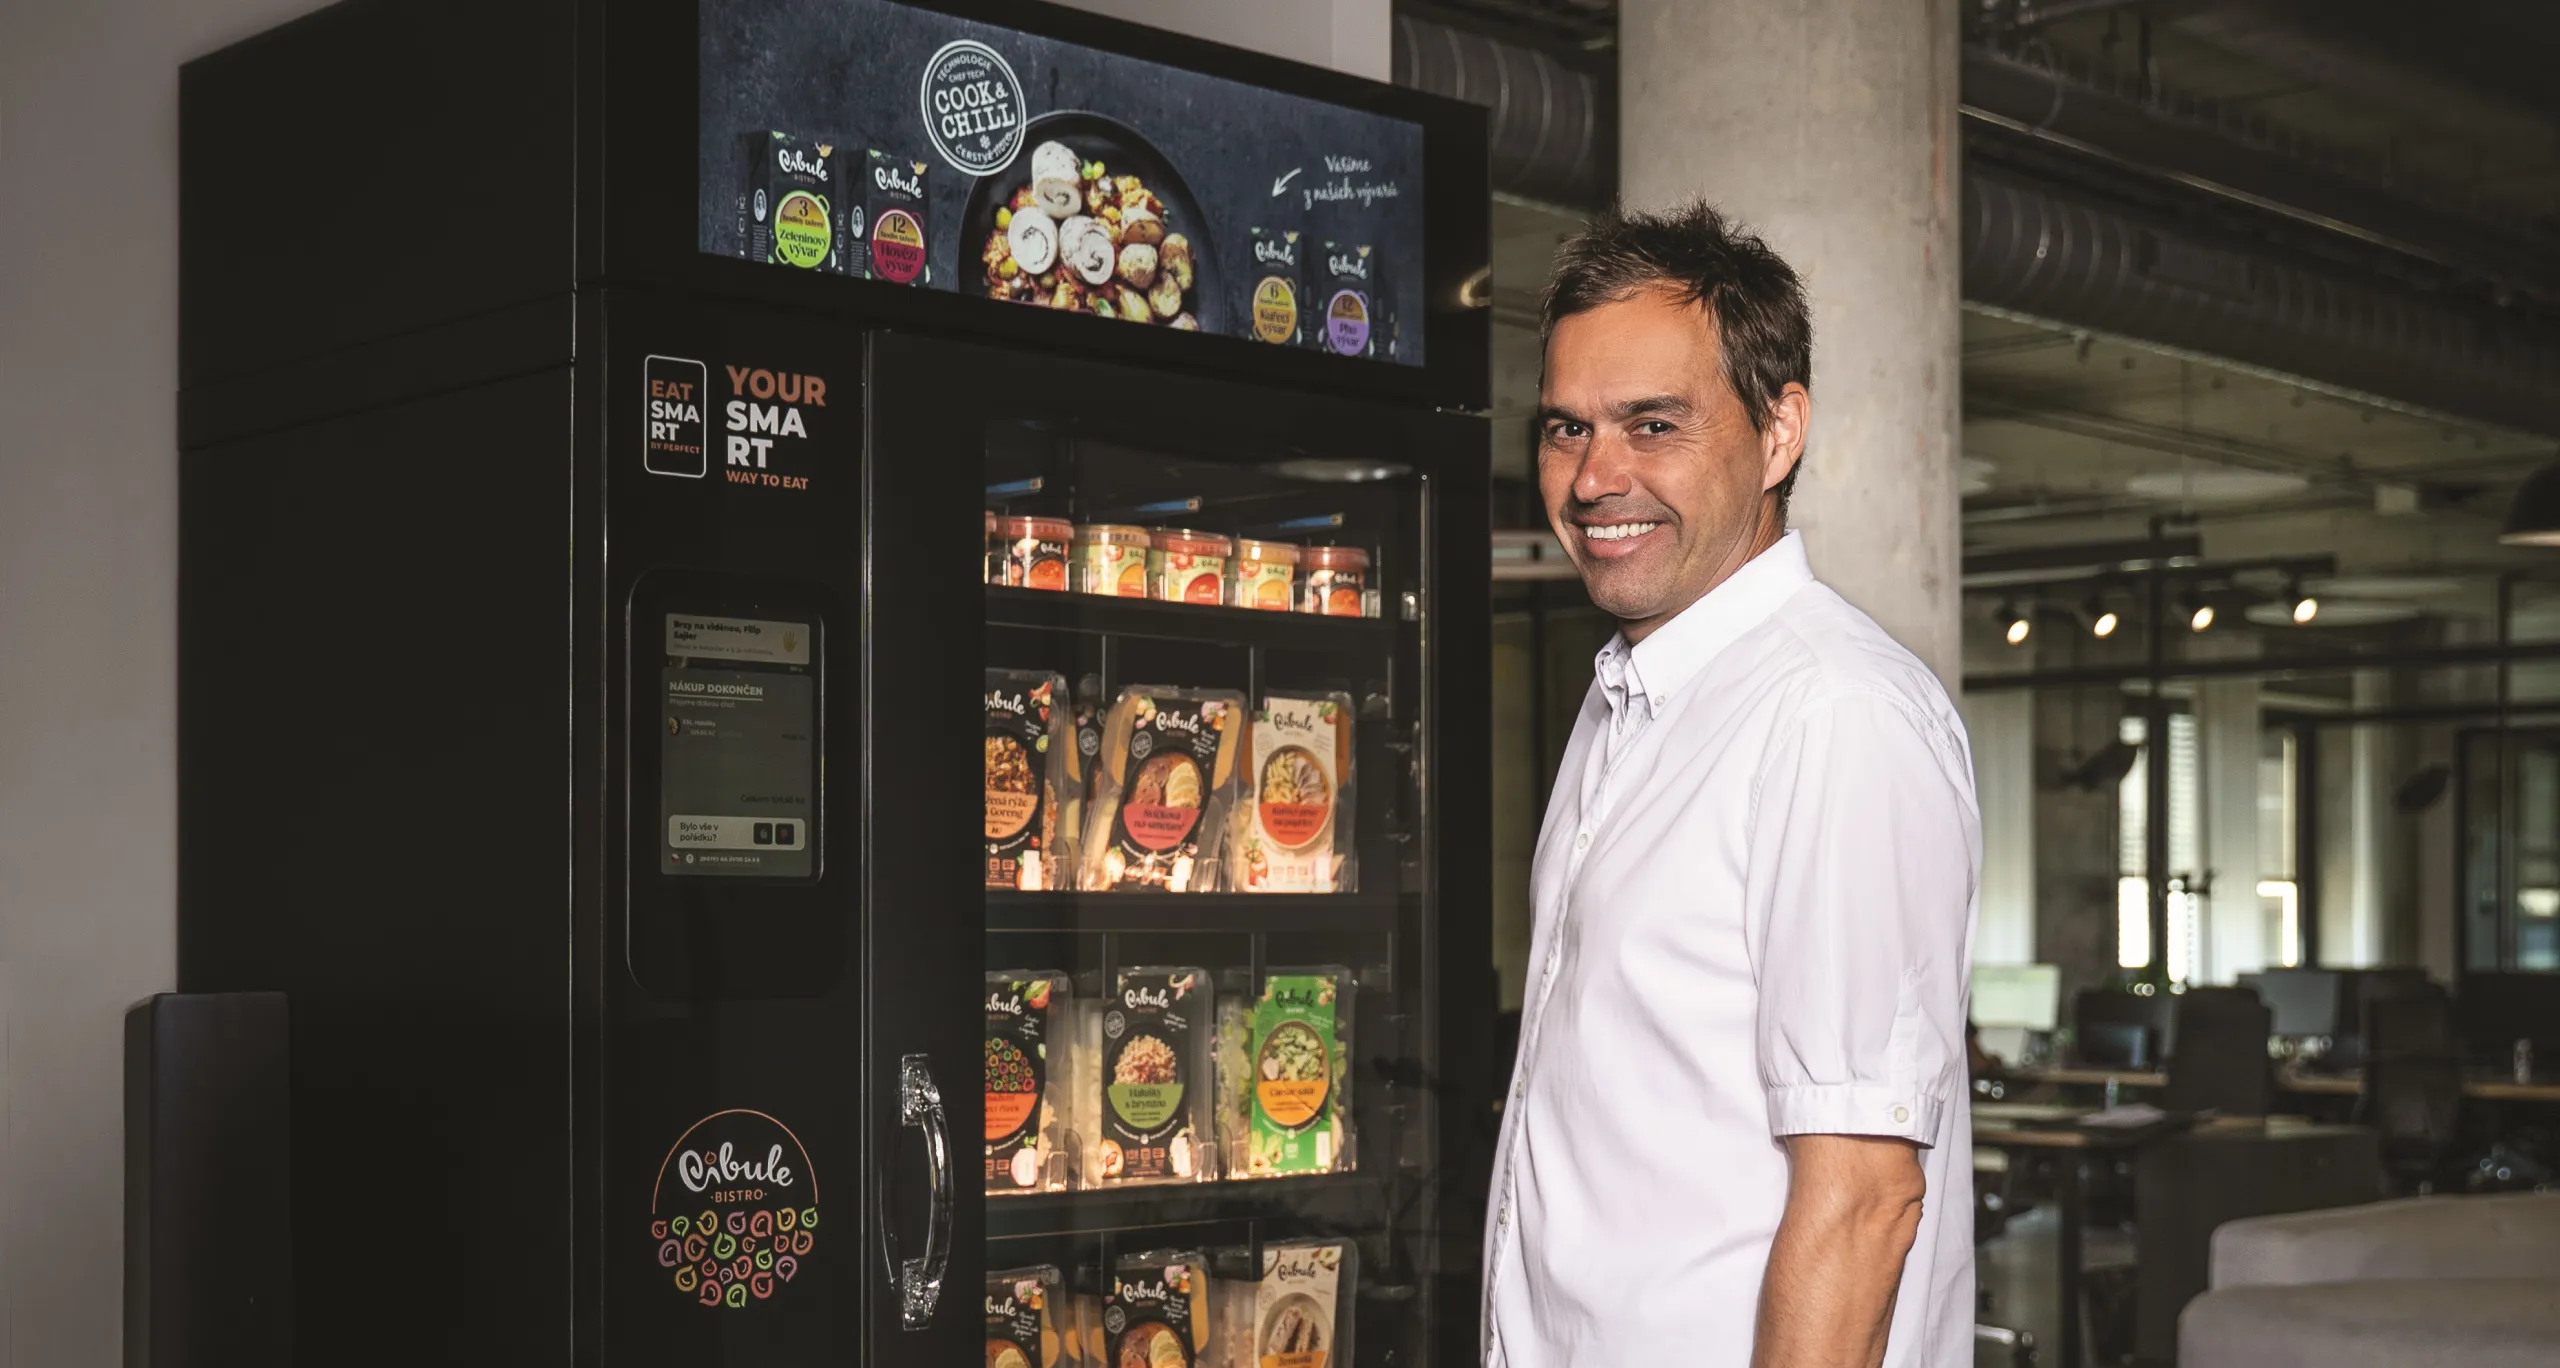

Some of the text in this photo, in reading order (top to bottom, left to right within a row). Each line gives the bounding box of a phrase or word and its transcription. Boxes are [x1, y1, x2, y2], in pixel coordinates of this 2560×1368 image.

[937, 53, 992, 82] TECHNOLOGIE
[966, 69, 986, 80] TECH
[941, 102, 1016, 139] CHILL
[778, 148, 828, 182] Cibule
[875, 166, 923, 199] Cibule
[798, 200, 809, 217] 3
[892, 216, 906, 234] 12
[780, 228, 828, 249] Zeleninový
[788, 243, 818, 258] vývar
[885, 260, 914, 274] vývar
[651, 379, 694, 402] EAT
[726, 364, 827, 407] YOUR
[651, 400, 700, 423] SMA
[726, 400, 808, 439] SMA
[651, 421, 680, 442] RT
[650, 442, 700, 454] BY PERFECT
[727, 435, 774, 469] RT
[726, 470, 808, 490] WAY TO EAT
[669, 680, 764, 696] NÁKUP DOKONČEN
[1156, 710, 1200, 734] Cibule
[680, 822, 698, 832] Bylo
[700, 823, 712, 831] vše
[680, 833, 718, 842] pořádku?
[1124, 986, 1170, 1009] Cibule
[678, 1141, 794, 1193] Cibule
[1123, 1280, 1168, 1304] Cibule
